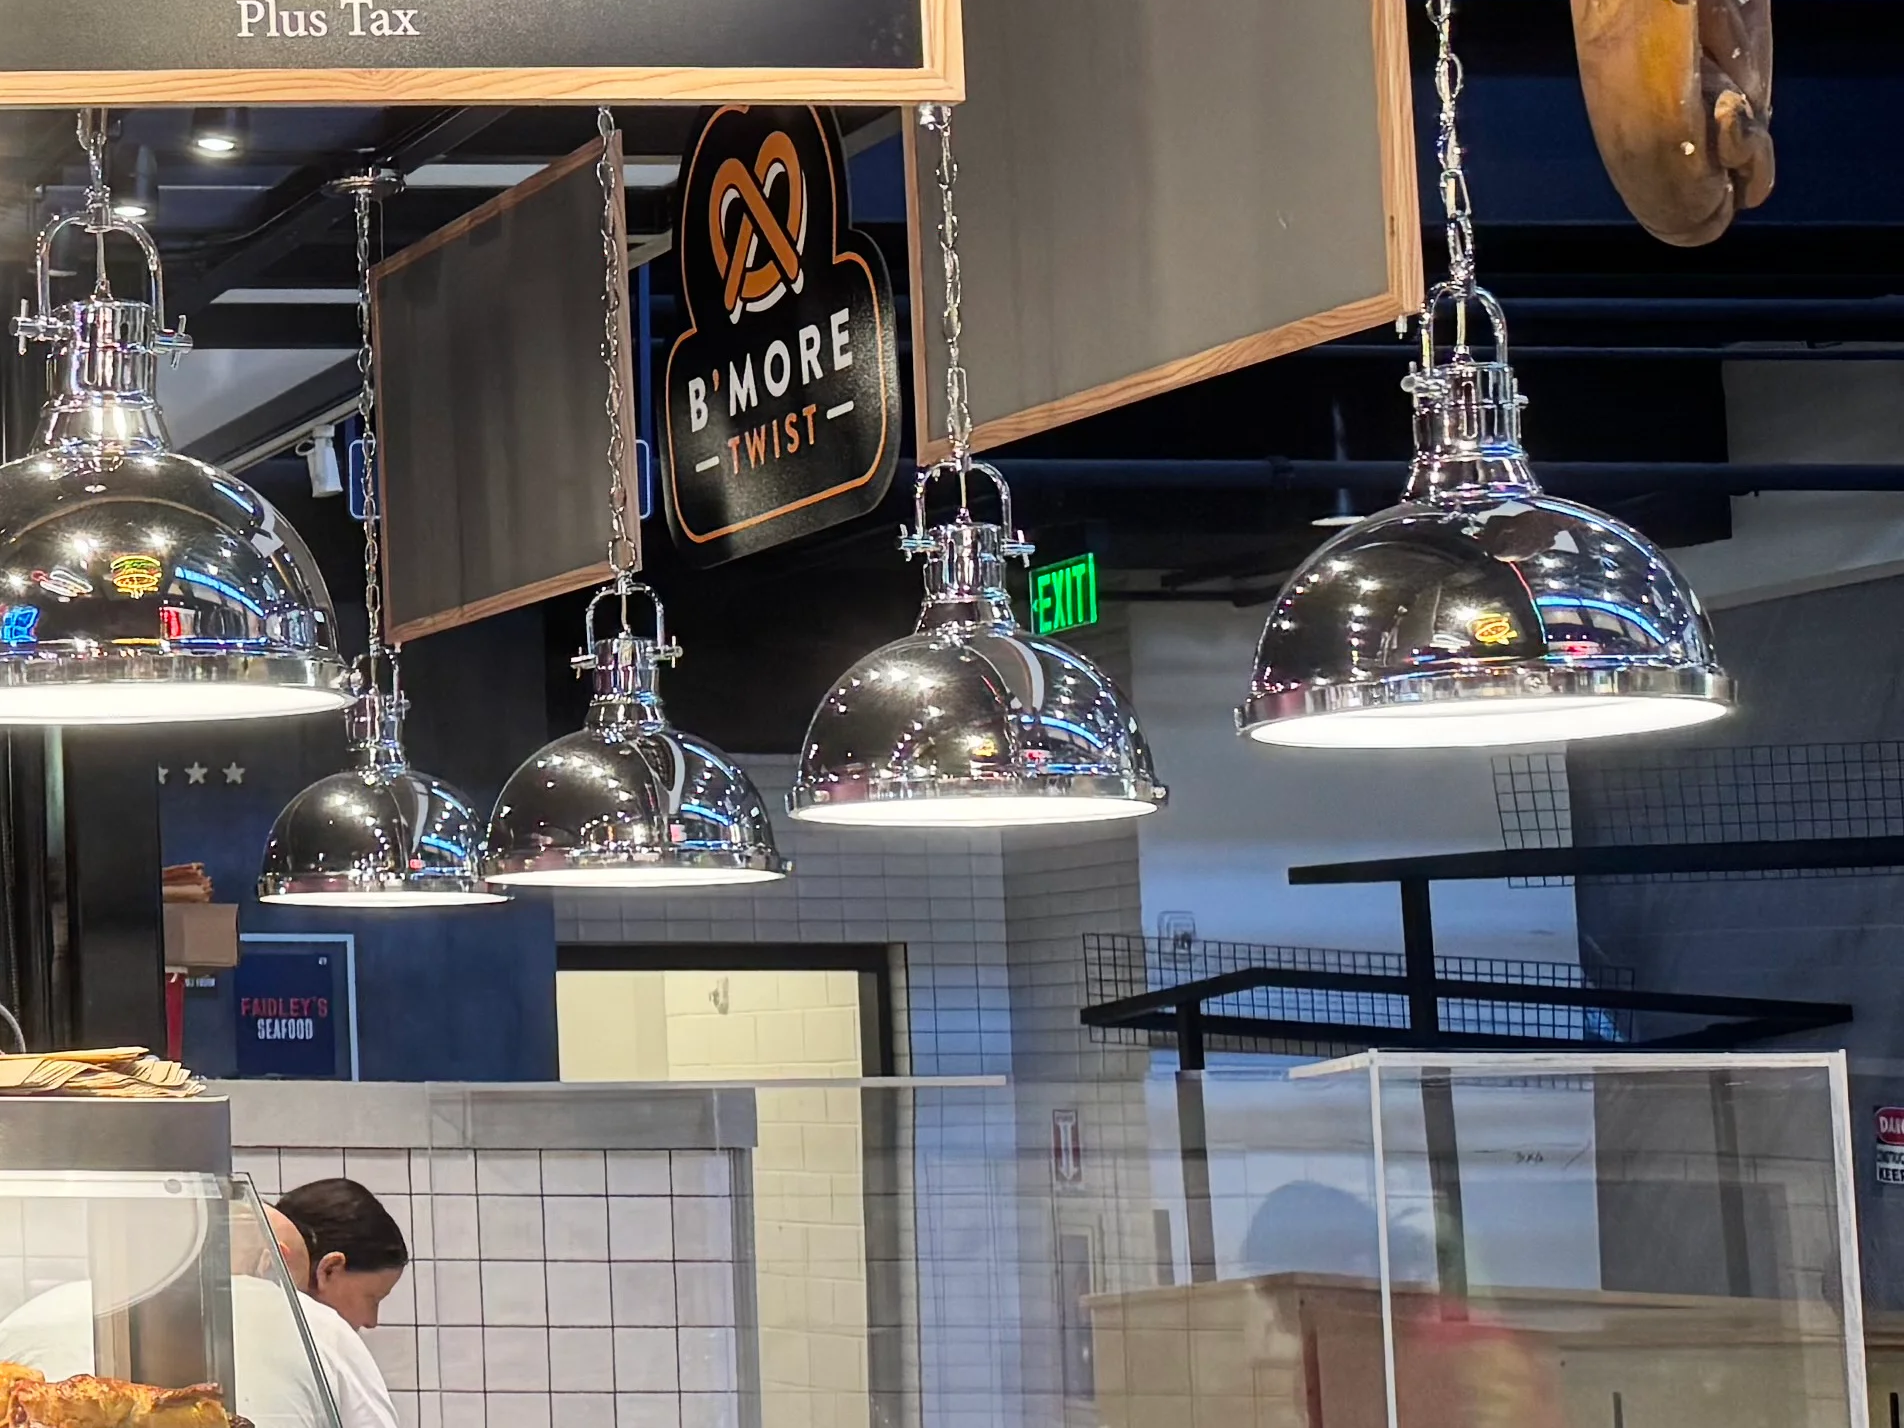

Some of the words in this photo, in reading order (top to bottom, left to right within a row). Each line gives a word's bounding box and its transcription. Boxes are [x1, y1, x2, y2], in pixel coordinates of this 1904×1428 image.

[688, 307, 853, 433] B'MORE
[728, 403, 817, 474] TWIST
[1037, 563, 1086, 634] EXIT
[241, 997, 328, 1018] FAIDLEY'S
[257, 1018, 314, 1040] SEAFOOD
